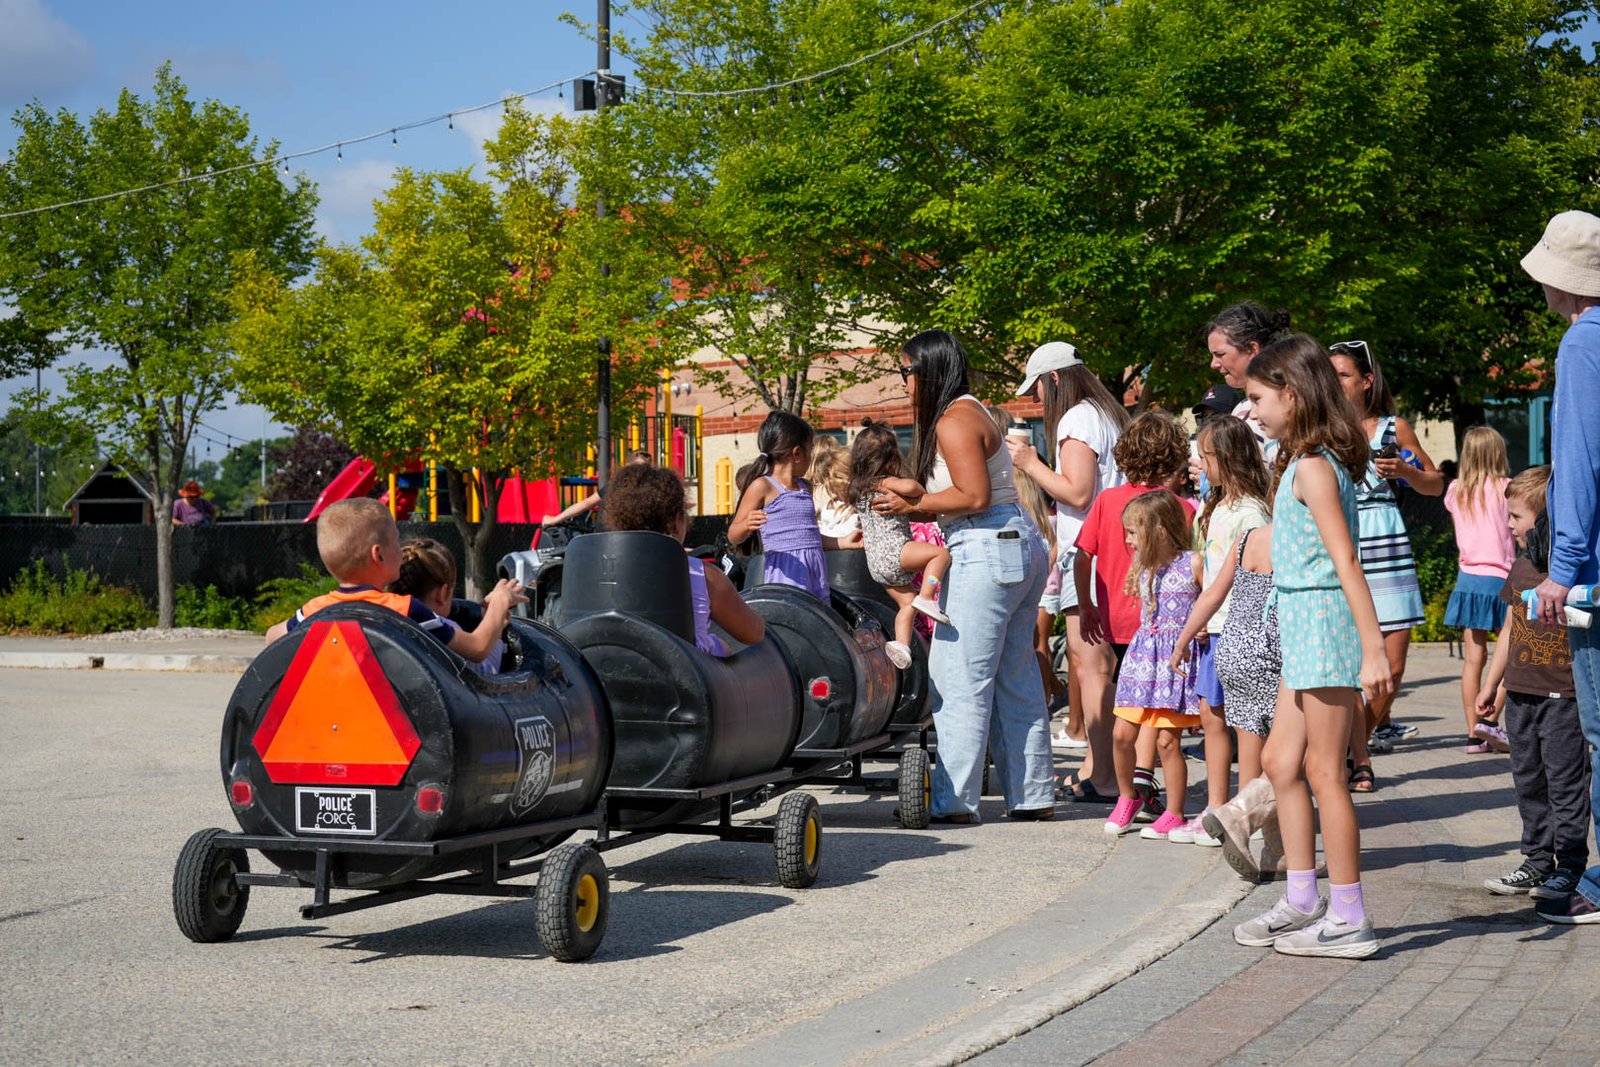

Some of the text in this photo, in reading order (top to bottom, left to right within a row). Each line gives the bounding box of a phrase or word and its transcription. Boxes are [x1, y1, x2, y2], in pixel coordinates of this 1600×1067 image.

[520, 723, 551, 751] POLICE
[318, 796, 353, 812] POLICE
[316, 811, 356, 825] FORCE
